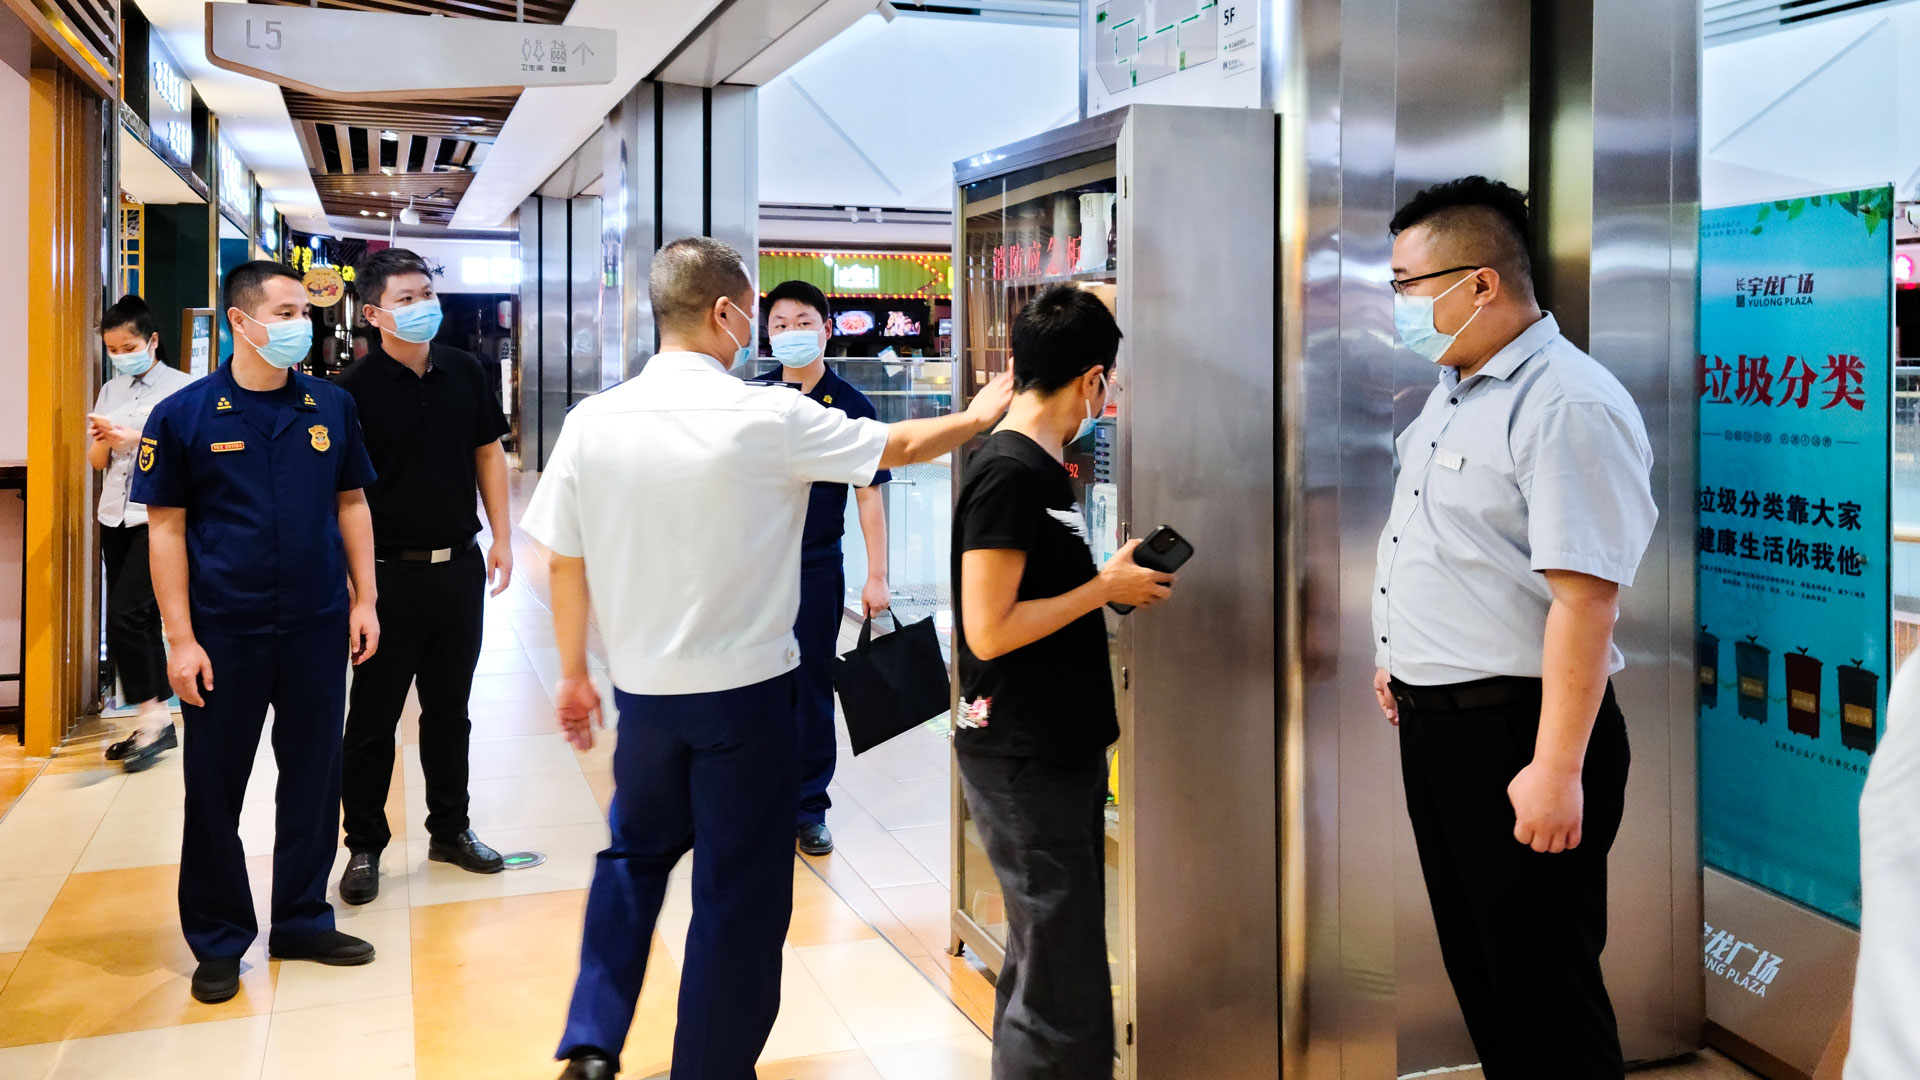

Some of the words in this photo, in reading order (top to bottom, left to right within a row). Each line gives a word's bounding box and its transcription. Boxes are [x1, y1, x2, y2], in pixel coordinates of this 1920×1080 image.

[1224, 7, 1235, 25] 5F
[246, 20, 282, 50] L5
[1748, 298, 1782, 307] YULONG
[1785, 297, 1813, 305] PLAZA
[1697, 354, 1866, 411] 垃圾分类
[1699, 486, 1862, 531] 垃圾分类靠大家
[1699, 526, 1862, 577] 健康生活你我他
[1704, 922, 1784, 985] 龙广场
[1726, 968, 1766, 998] PLAZA
